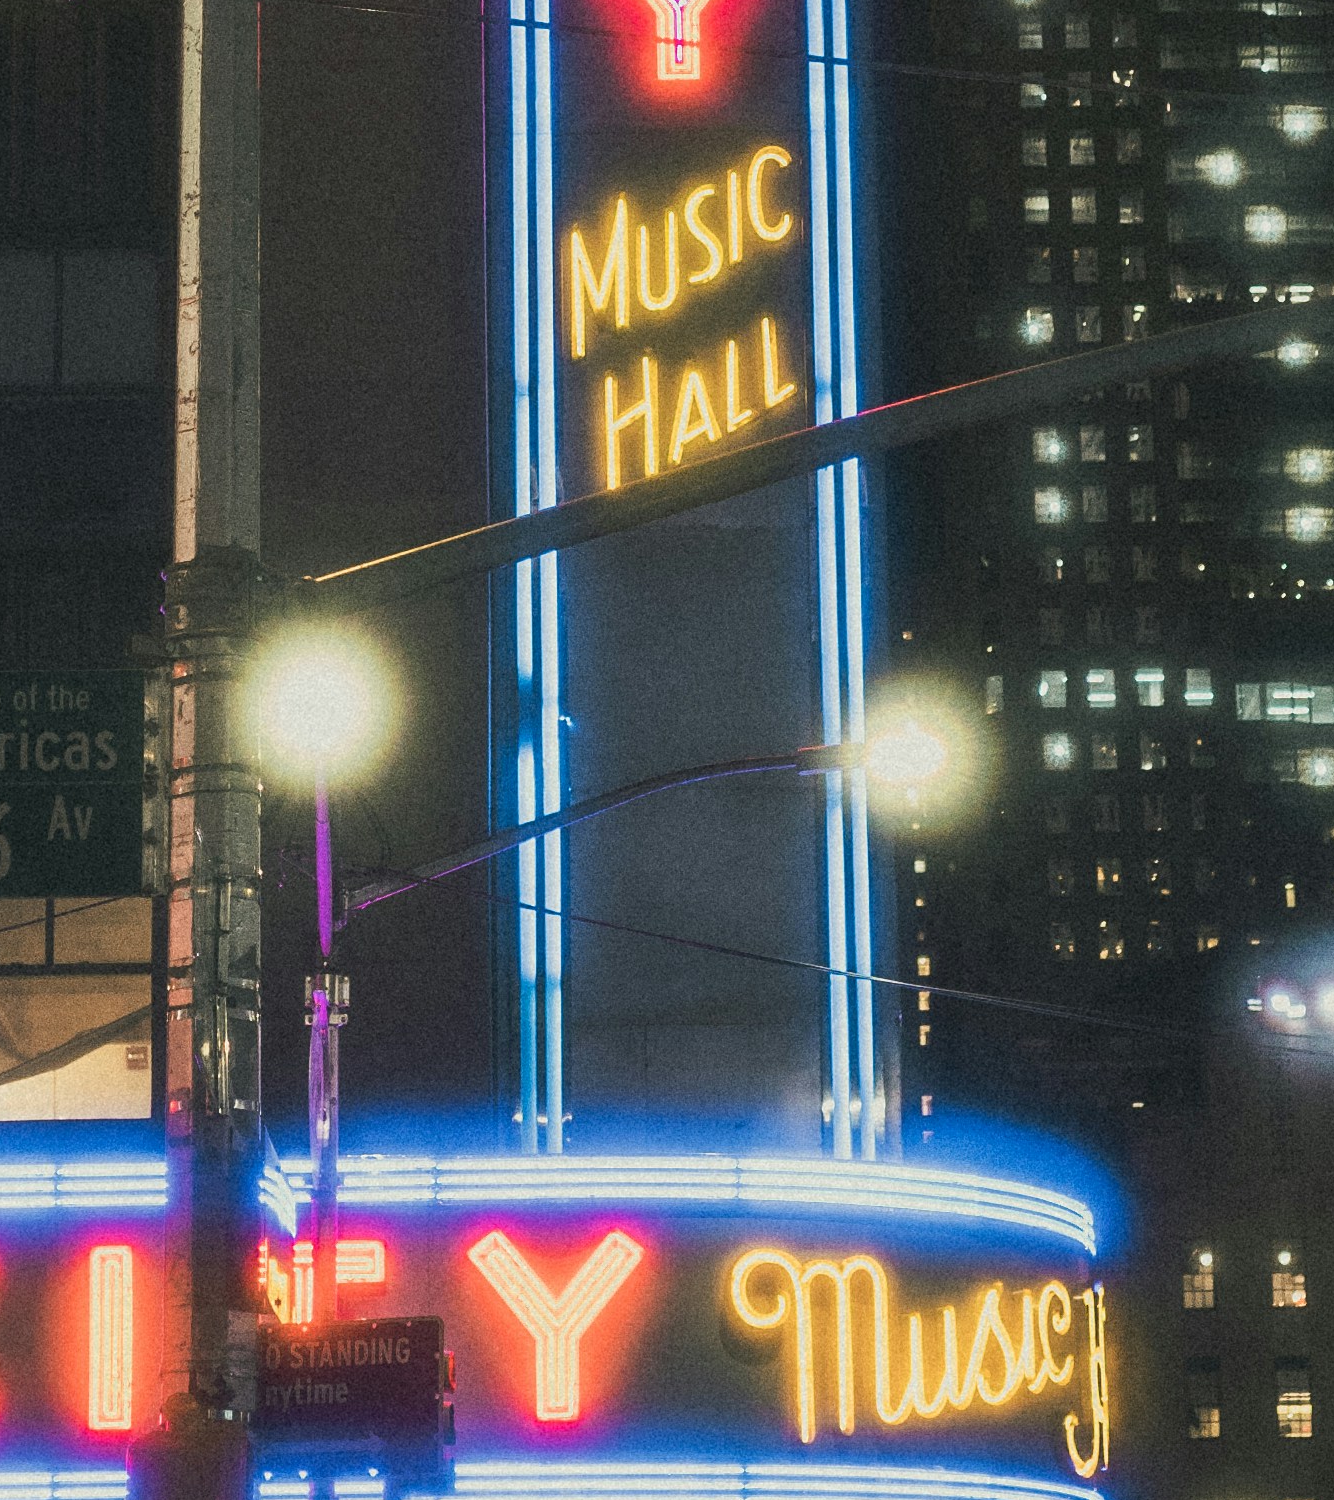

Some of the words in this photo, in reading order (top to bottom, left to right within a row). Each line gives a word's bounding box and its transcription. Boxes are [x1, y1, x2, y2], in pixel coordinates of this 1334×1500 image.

[571, 145, 793, 360] MUSIC
[604, 318, 795, 490] HALL
[13, 684, 38, 711] of
[45, 685, 91, 710] the
[47, 795, 94, 841] Av
[290, 1336, 411, 1369] STANDING
[730, 1247, 1073, 1443] Music
[265, 1377, 349, 1411] nytime
